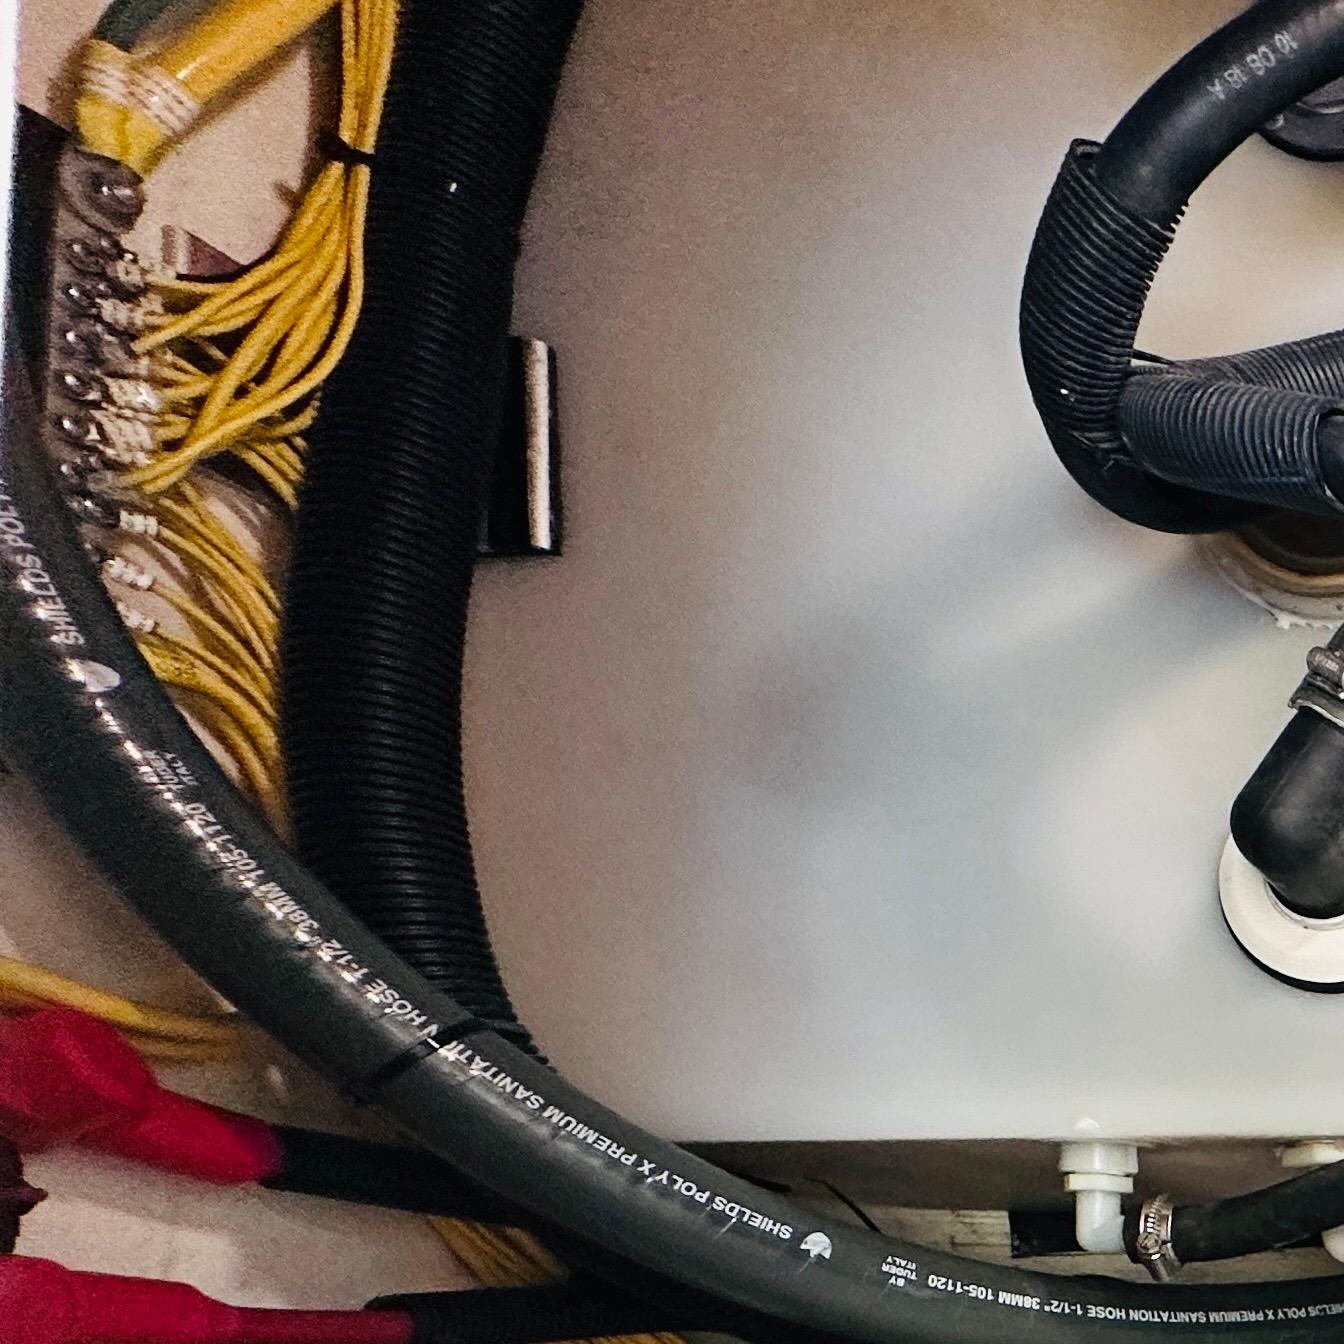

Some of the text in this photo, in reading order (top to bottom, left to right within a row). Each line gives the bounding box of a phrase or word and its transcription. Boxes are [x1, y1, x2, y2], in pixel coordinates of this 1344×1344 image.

[14, 550, 85, 643] SHIELDS
[182, 799, 263, 884] 105-1120
[364, 976, 428, 1026] HOSE
[542, 1103, 637, 1166] PREMIUM
[635, 1158, 655, 1176] X
[653, 1169, 710, 1203] POLY
[711, 1195, 793, 1240] SHIELDS
[885, 1254, 916, 1269] ITALY
[881, 1262, 917, 1280] TUDER
[888, 1275, 904, 1286] BY
[926, 1273, 995, 1301] 105-1120
[997, 1290, 1040, 1309] 38MM
[1043, 1298, 1083, 1315] 1-1/2"
[1086, 1304, 1126, 1319] HOSE
[1129, 1308, 1206, 1322] SANITATION
[1208, 1309, 1263, 1322] PREMIUM
[1264, 1308, 1274, 1319] X
[1276, 1306, 1306, 1318] POLY
